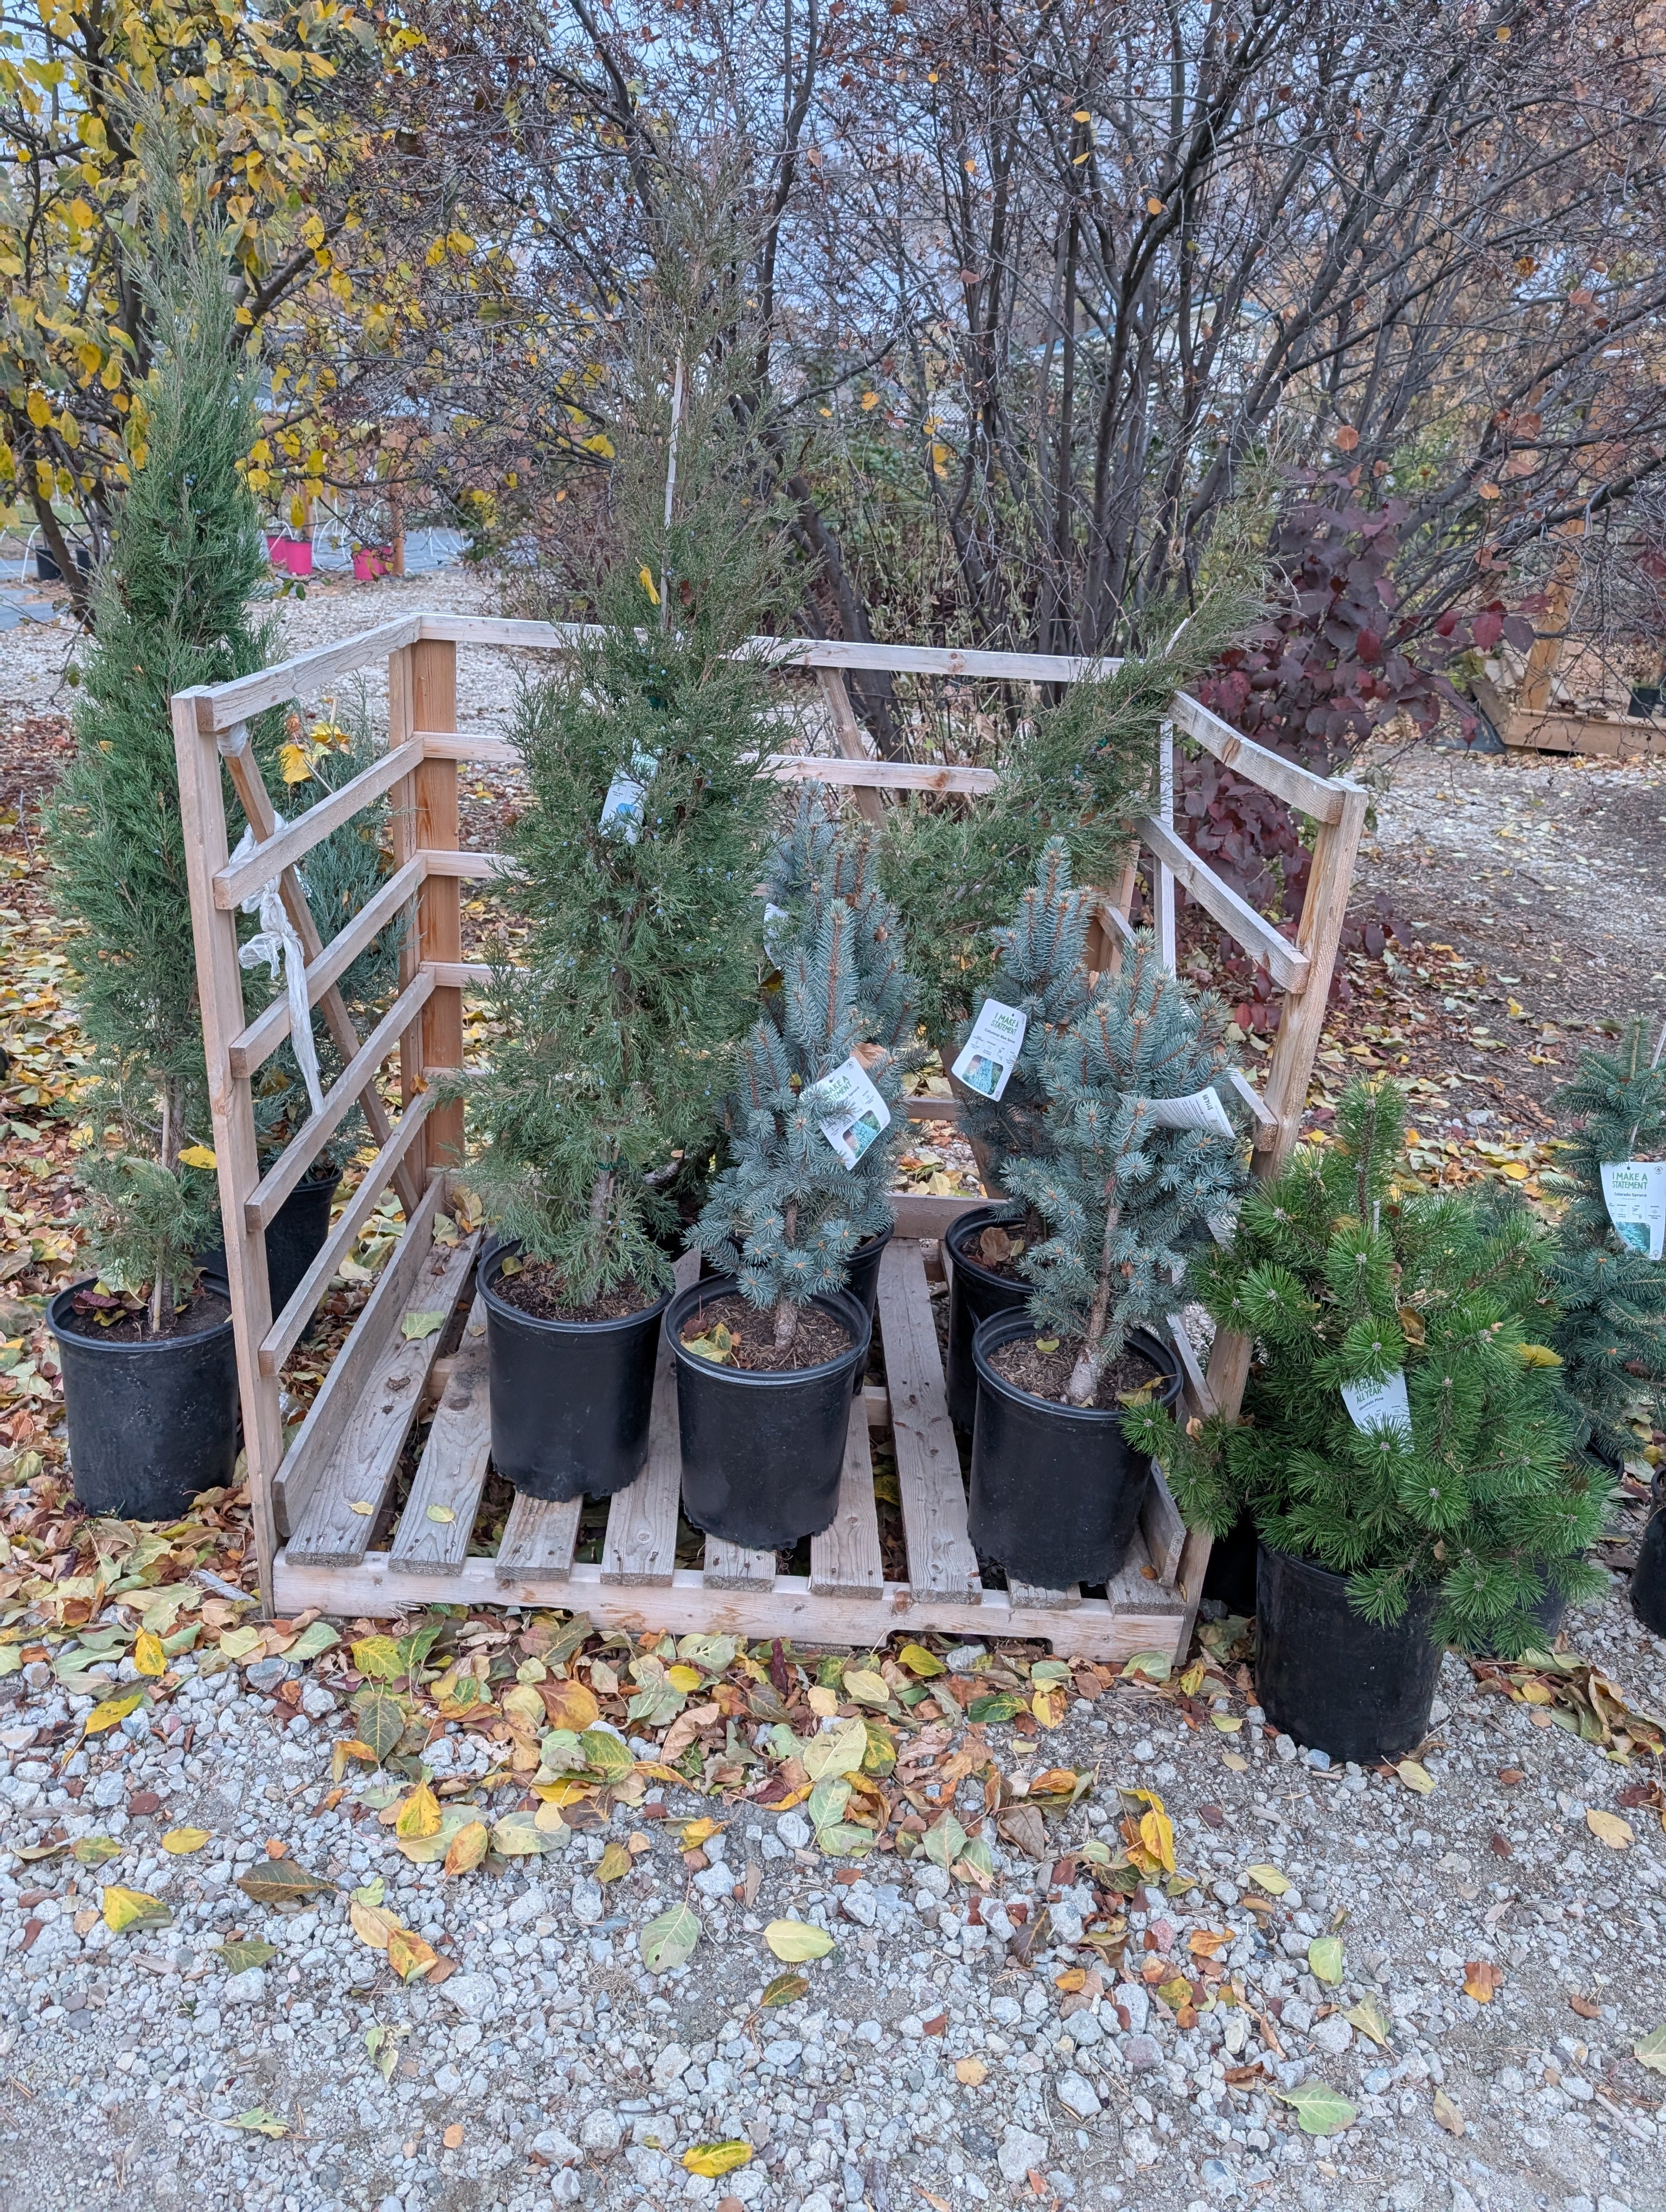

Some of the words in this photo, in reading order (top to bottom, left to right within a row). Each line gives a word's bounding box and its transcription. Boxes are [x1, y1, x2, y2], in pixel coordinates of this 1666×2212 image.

[990, 1019, 1017, 1036] STATEMENT
[998, 1014, 1016, 1027] MAKE
[830, 1081, 851, 1101] TEMENT
[1202, 1094, 1214, 1110] $114.99
[1612, 1172, 1614, 1180] I
[1616, 1172, 1639, 1181] MAKE
[1642, 1173, 1648, 1181] A
[1612, 1181, 1648, 1189] STATEMENT
[1356, 1392, 1365, 1404] ALL
[1364, 1385, 1382, 1398] YEAR
[1359, 1400, 1374, 1411] Mountain
